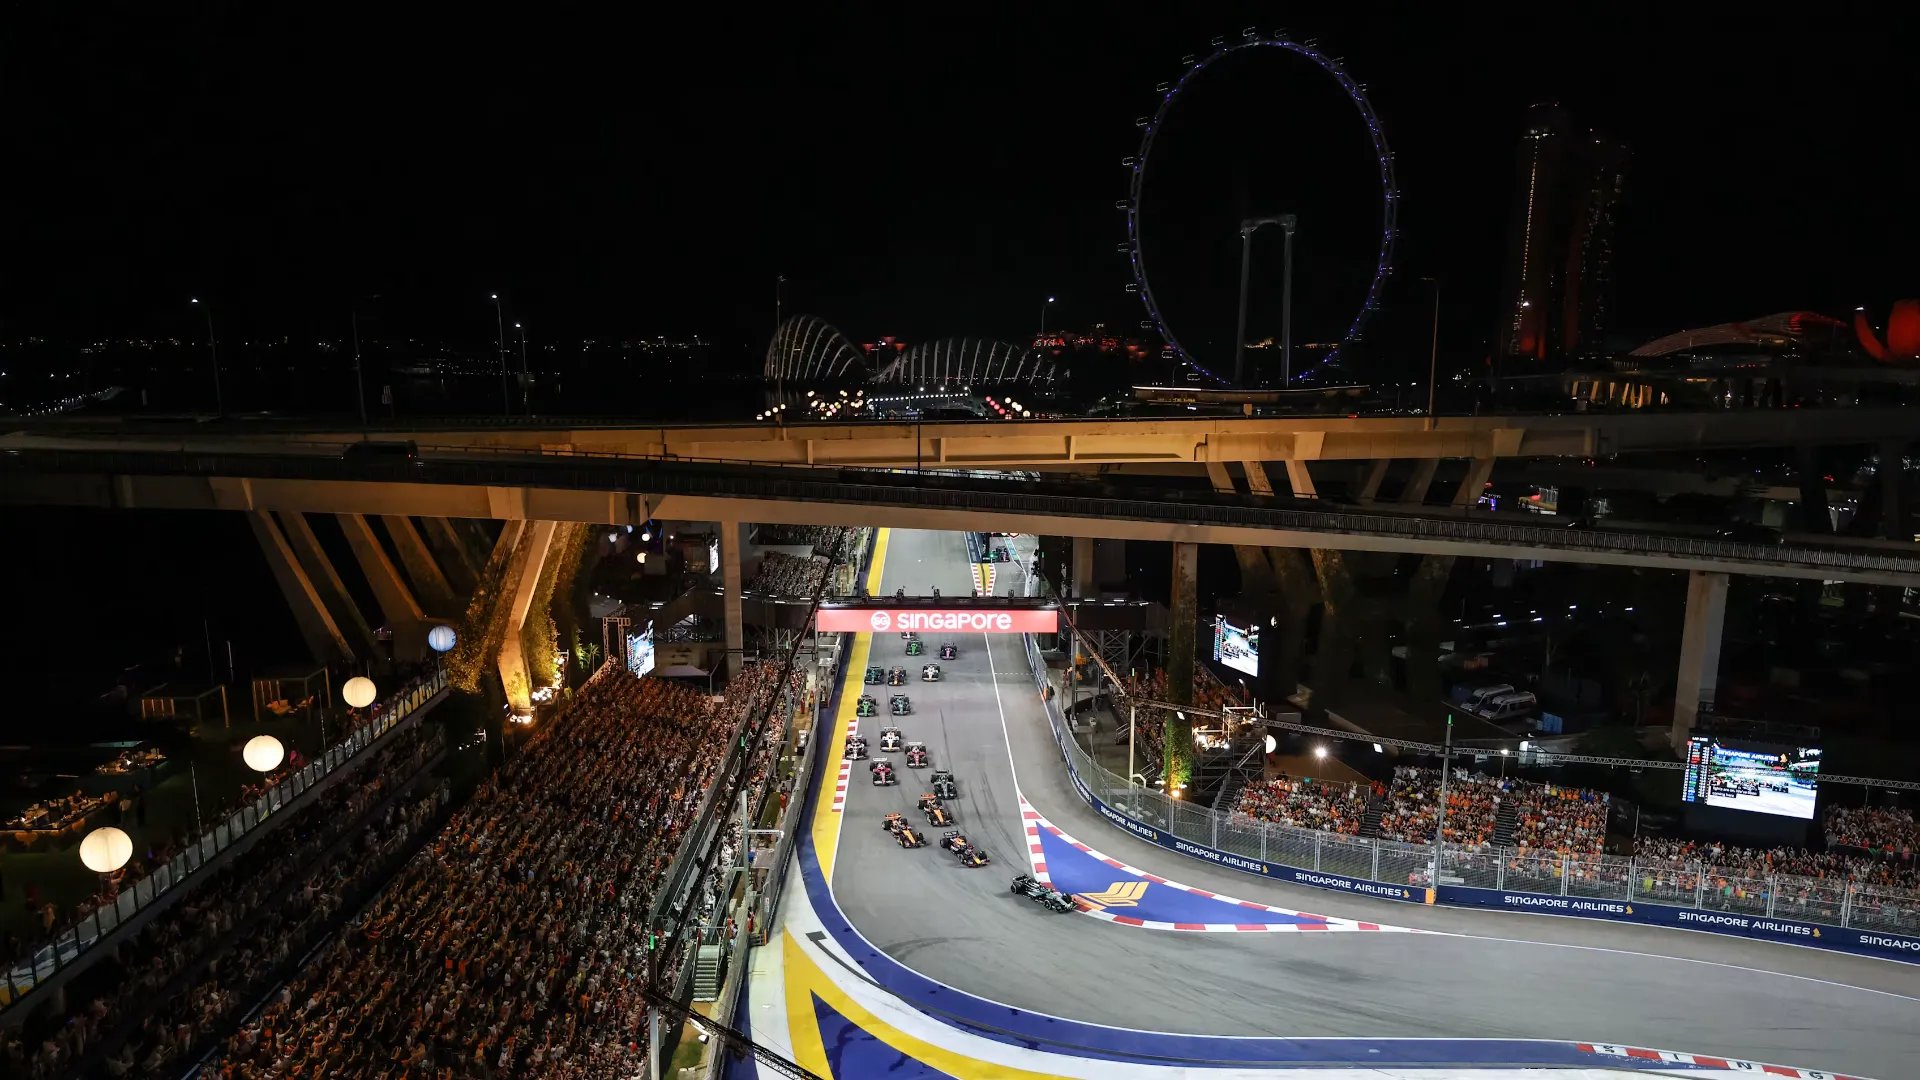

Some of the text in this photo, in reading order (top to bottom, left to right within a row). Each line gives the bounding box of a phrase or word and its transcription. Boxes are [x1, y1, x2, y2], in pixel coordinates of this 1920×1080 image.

[1127, 822, 1153, 838] AIRLINES
[1175, 841, 1262, 871] SINGAPORE AIRLINES
[1295, 872, 1402, 897] SINGAPORE AIRLINES
[1504, 895, 1624, 913] SINGAPORE AIRLINES
[1678, 912, 1811, 935] SINGAPORE AIRLINES
